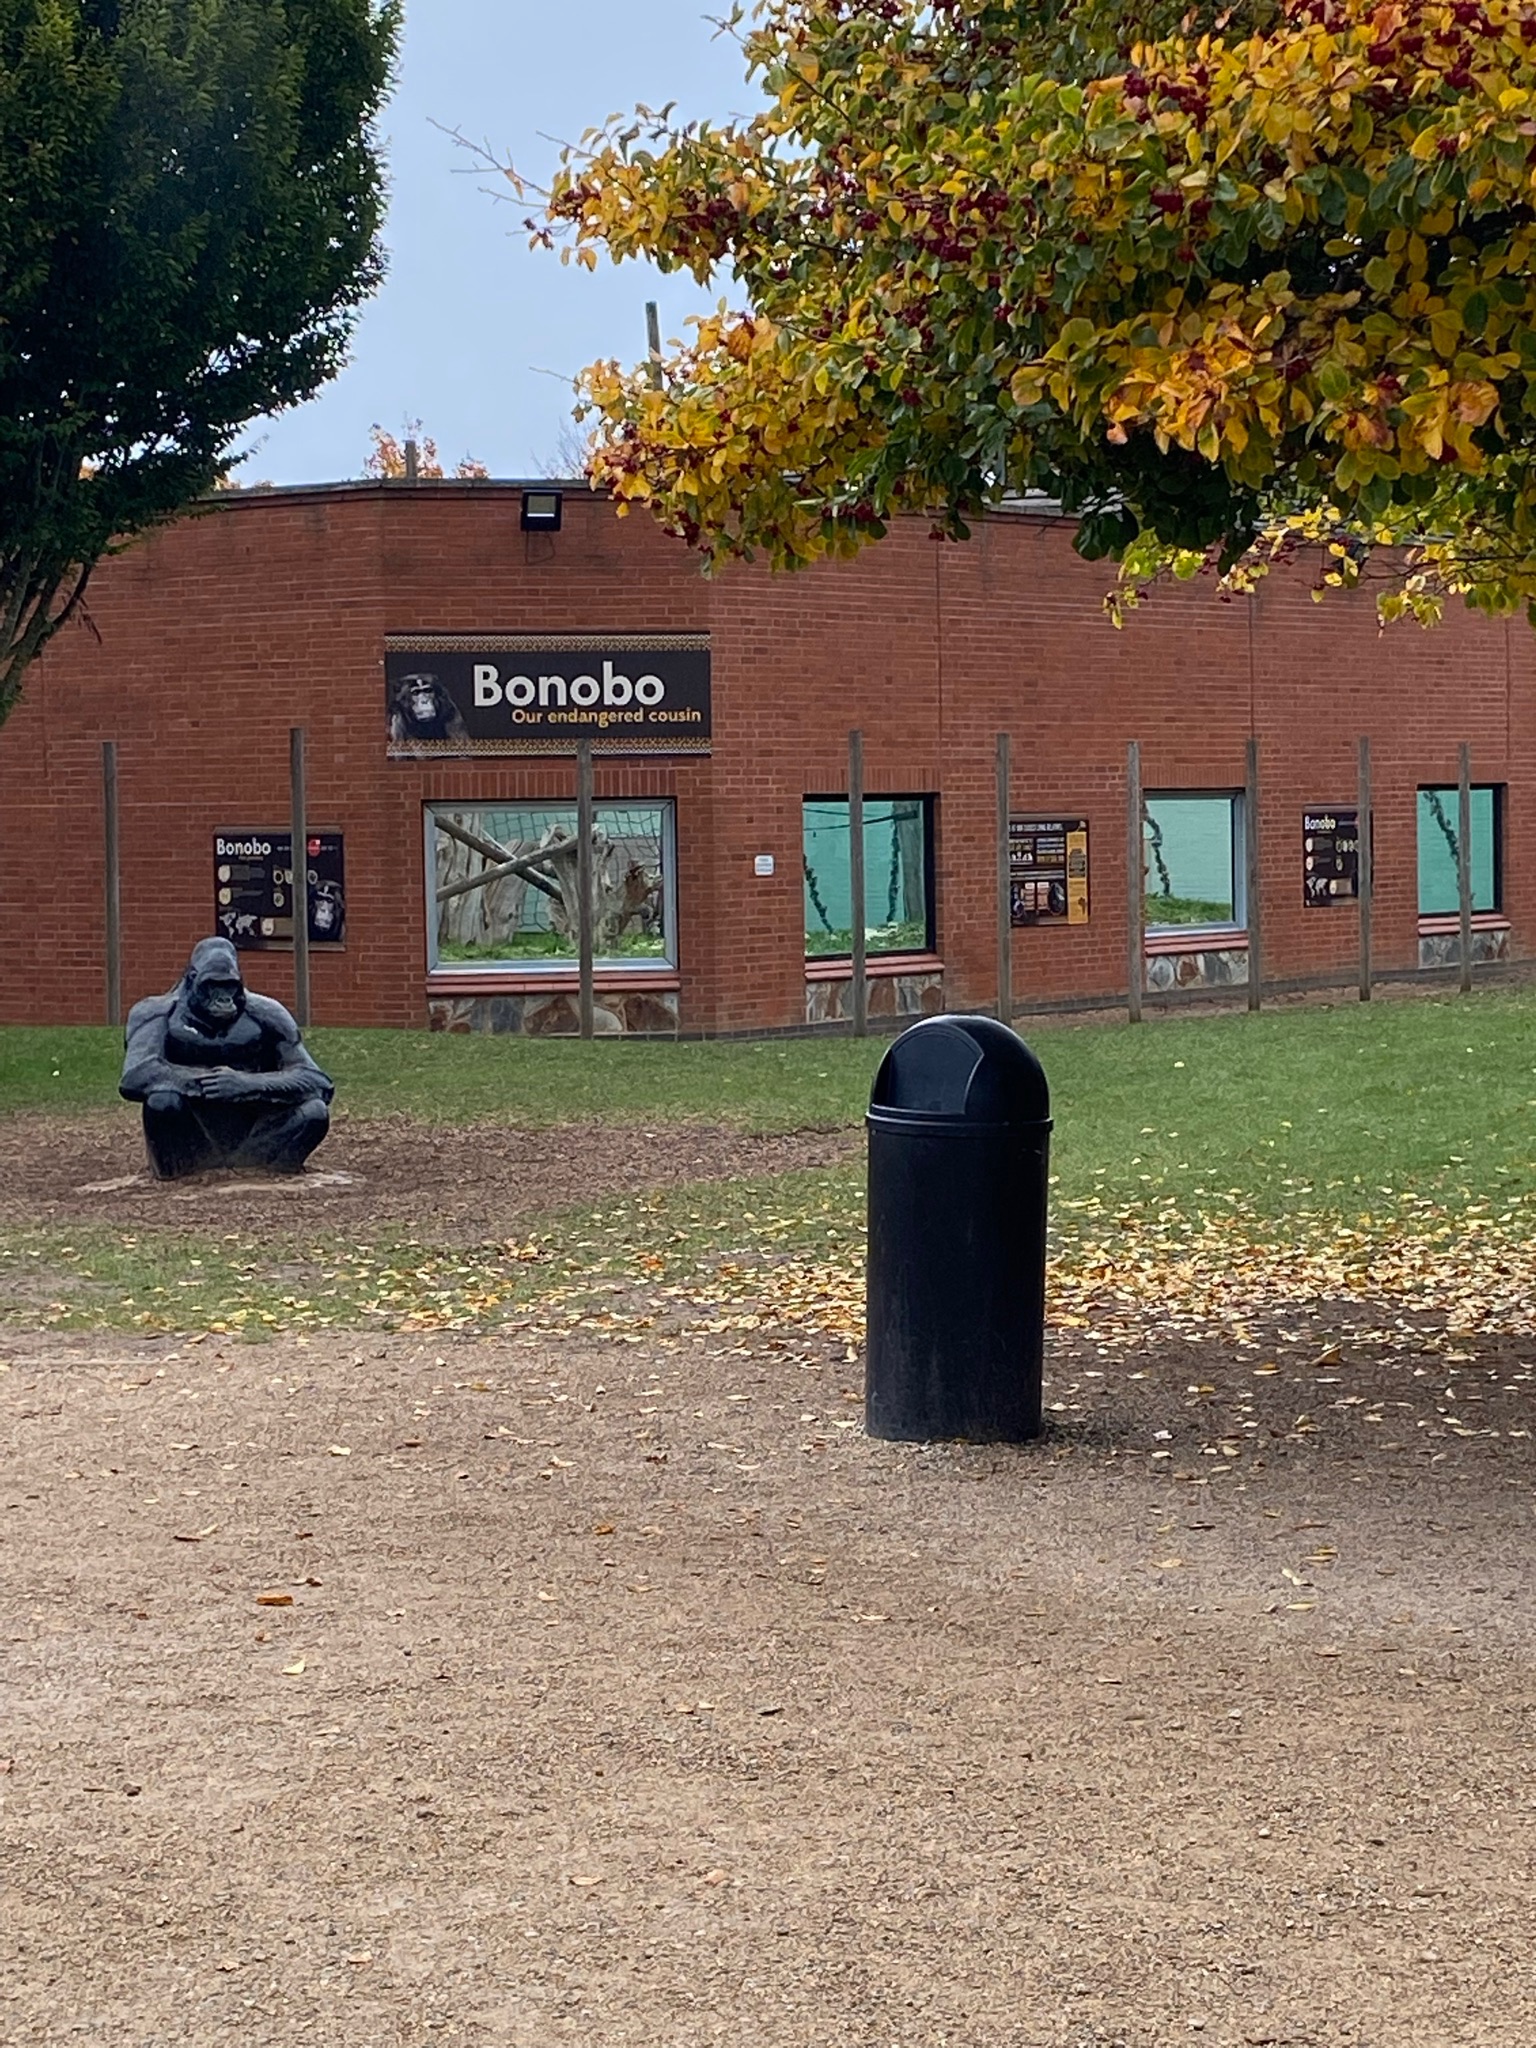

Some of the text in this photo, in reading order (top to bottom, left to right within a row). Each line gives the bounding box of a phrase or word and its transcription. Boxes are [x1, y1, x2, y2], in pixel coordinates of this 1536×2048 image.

[473, 661, 665, 707] Bonobo
[511, 706, 701, 727] Our endangered cousin
[1304, 814, 1336, 830] Bonobo
[216, 837, 271, 855] Bonobo
